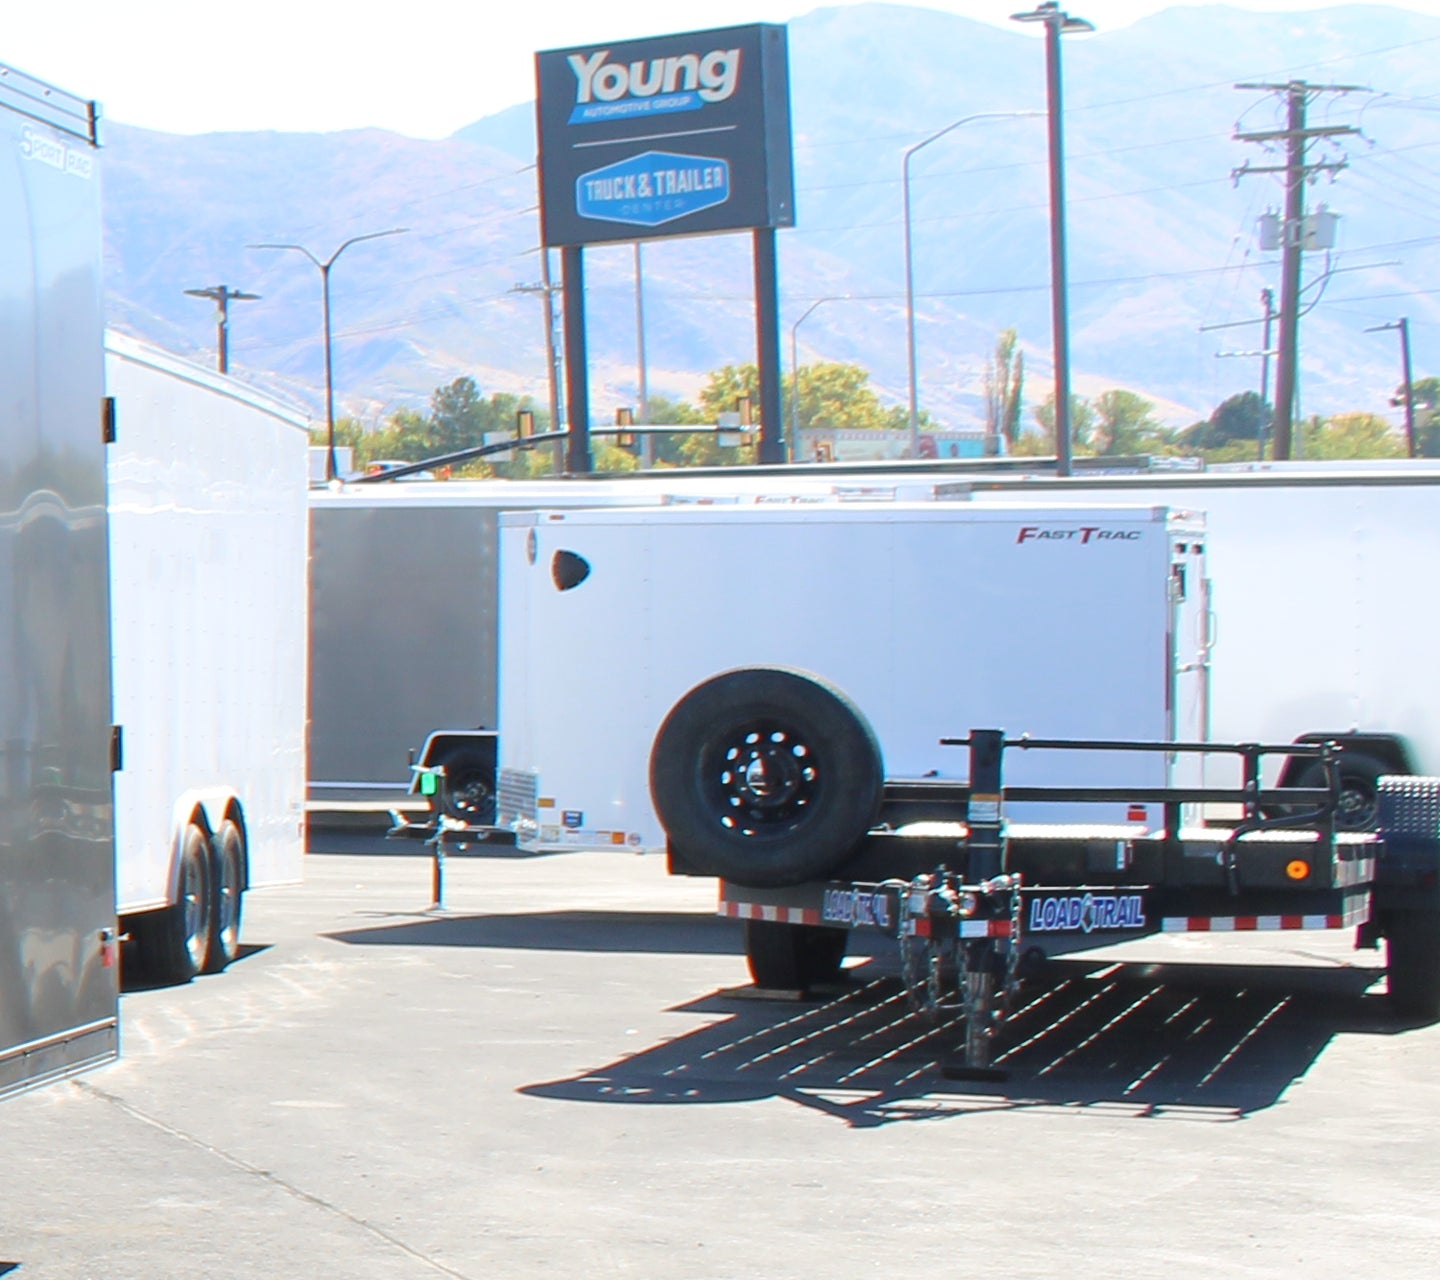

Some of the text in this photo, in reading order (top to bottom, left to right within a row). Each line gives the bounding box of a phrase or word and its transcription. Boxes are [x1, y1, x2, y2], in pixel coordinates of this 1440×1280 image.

[566, 47, 742, 104] Young
[582, 95, 693, 118] AUTOMOTIVE GROUP
[585, 166, 724, 202] TRUCK & TRAILER
[1030, 895, 1146, 931] LOAD TRAIL
